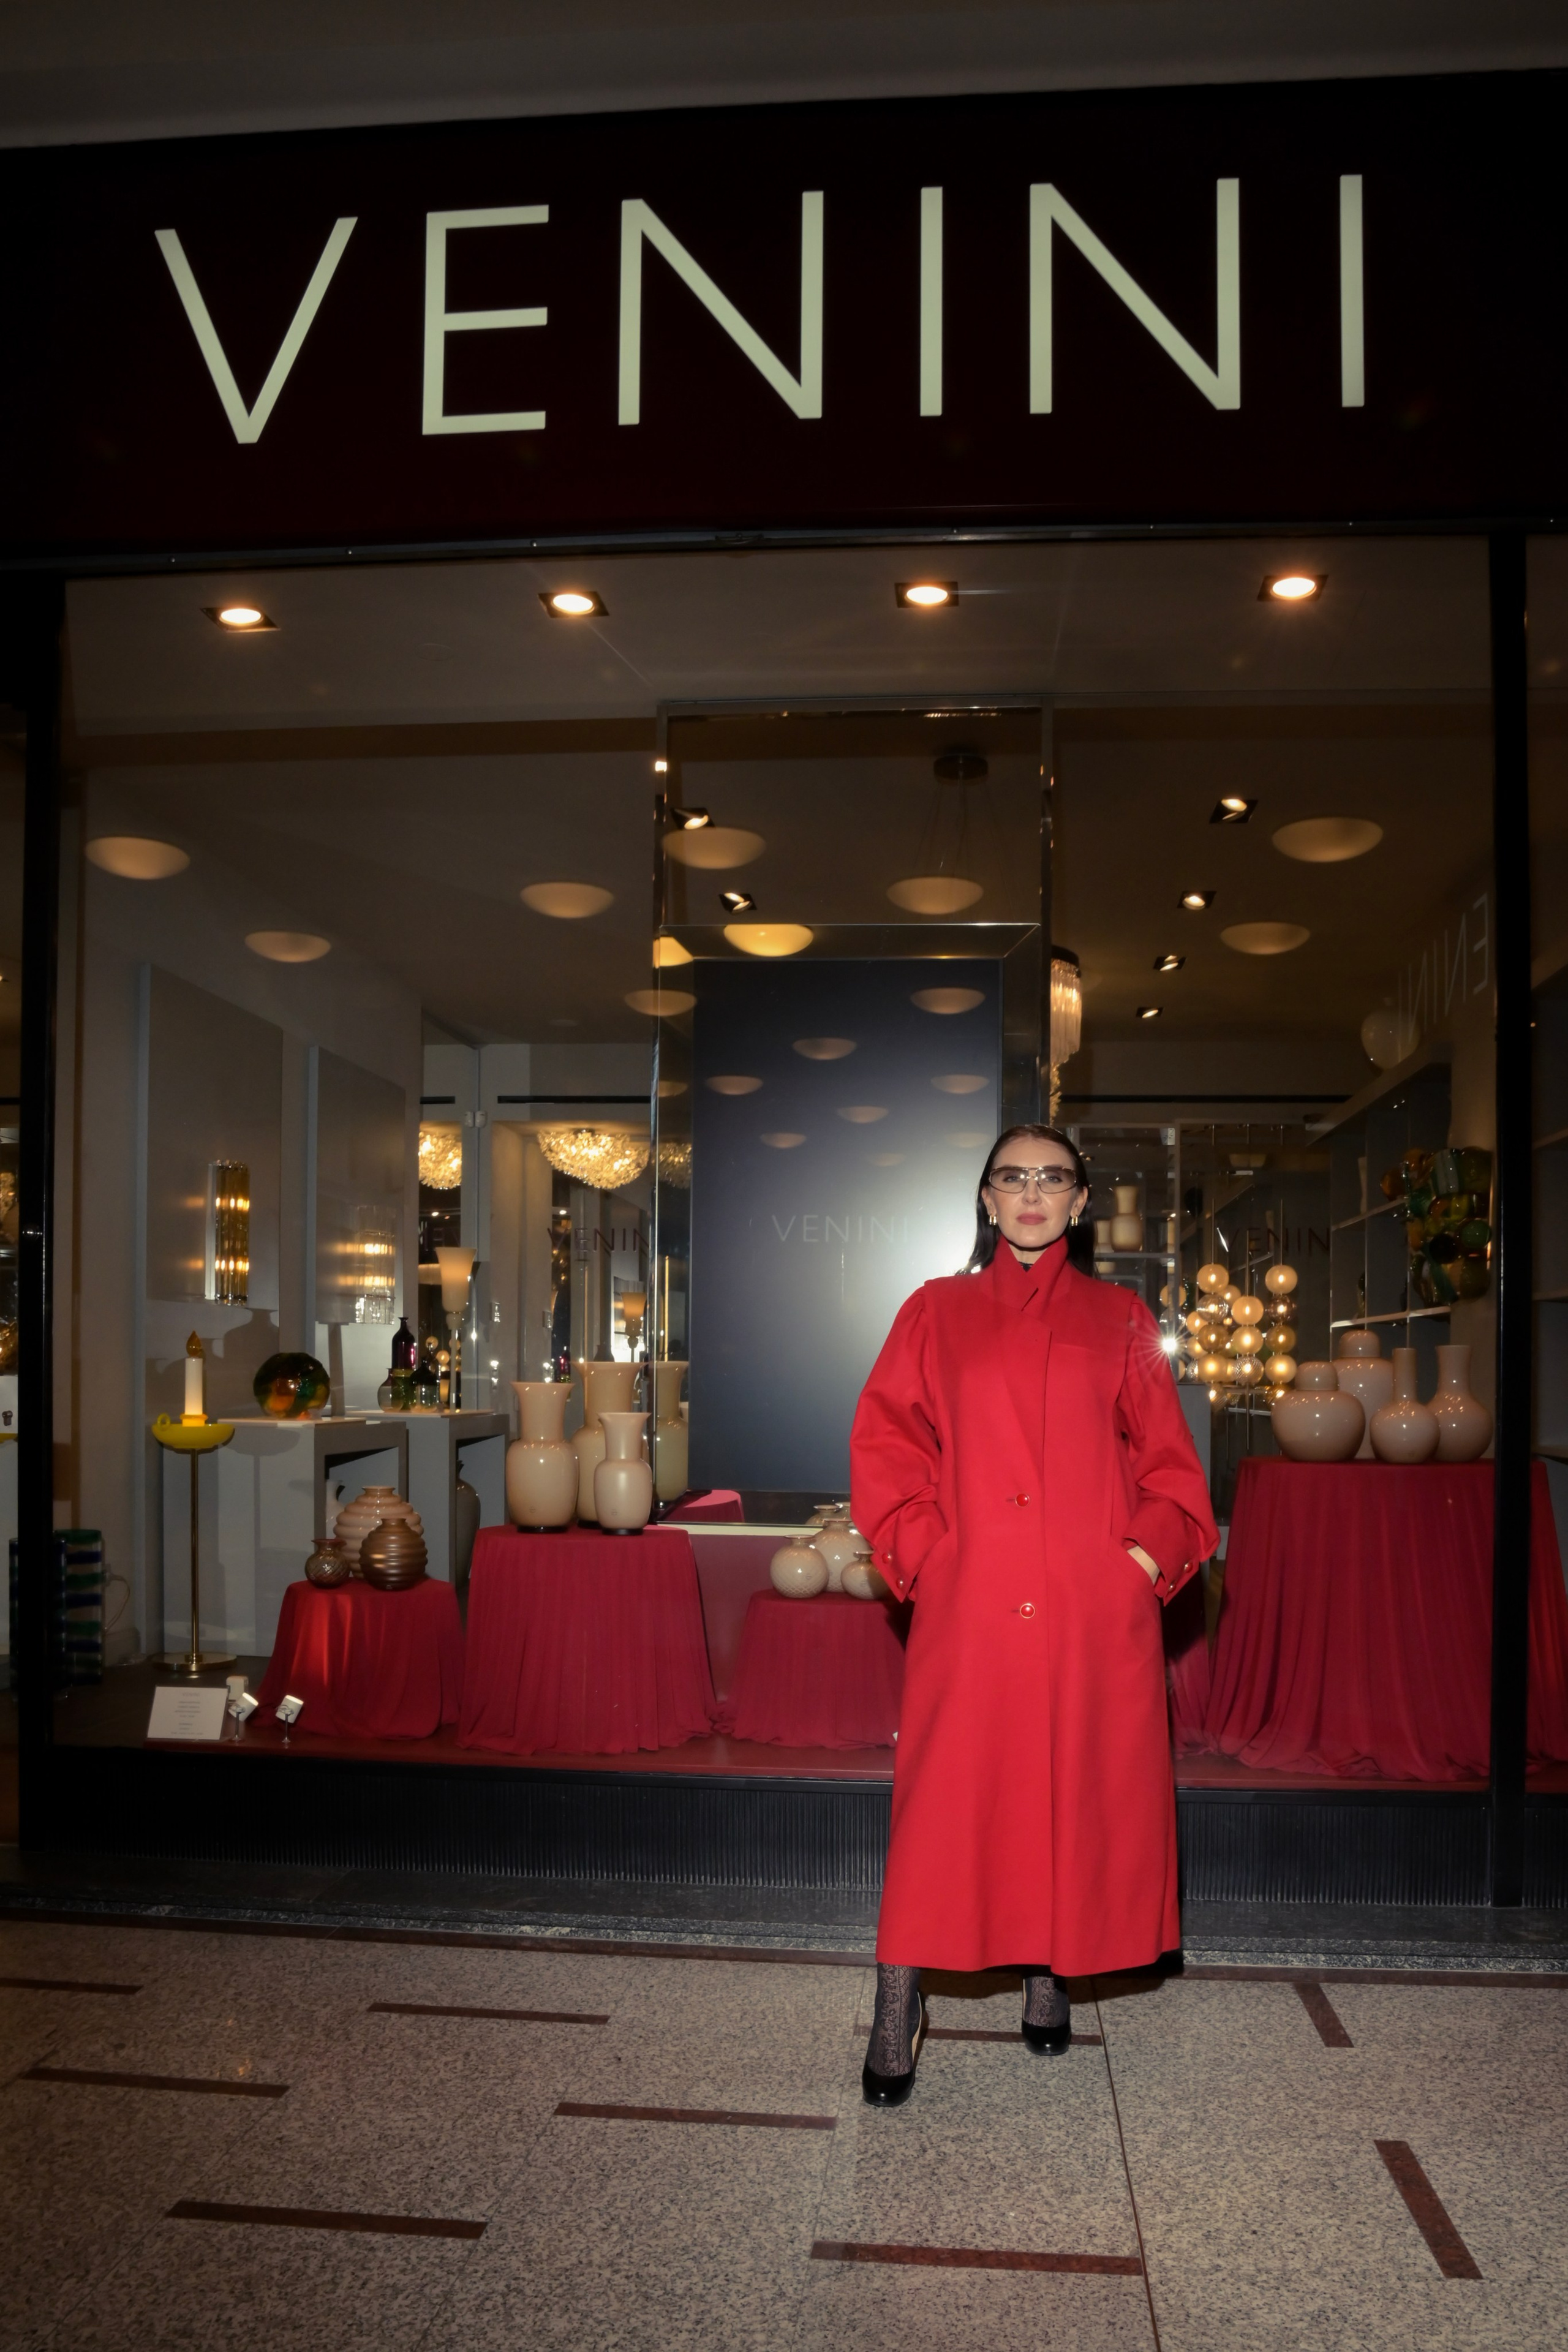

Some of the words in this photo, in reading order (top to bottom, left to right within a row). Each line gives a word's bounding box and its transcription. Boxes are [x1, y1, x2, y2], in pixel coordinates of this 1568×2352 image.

[154, 175, 1365, 444] VENINI
[547, 1227, 650, 1252] VENIN
[772, 1214, 908, 1243] VENINI
[1216, 1227, 1330, 1254] VENIN
